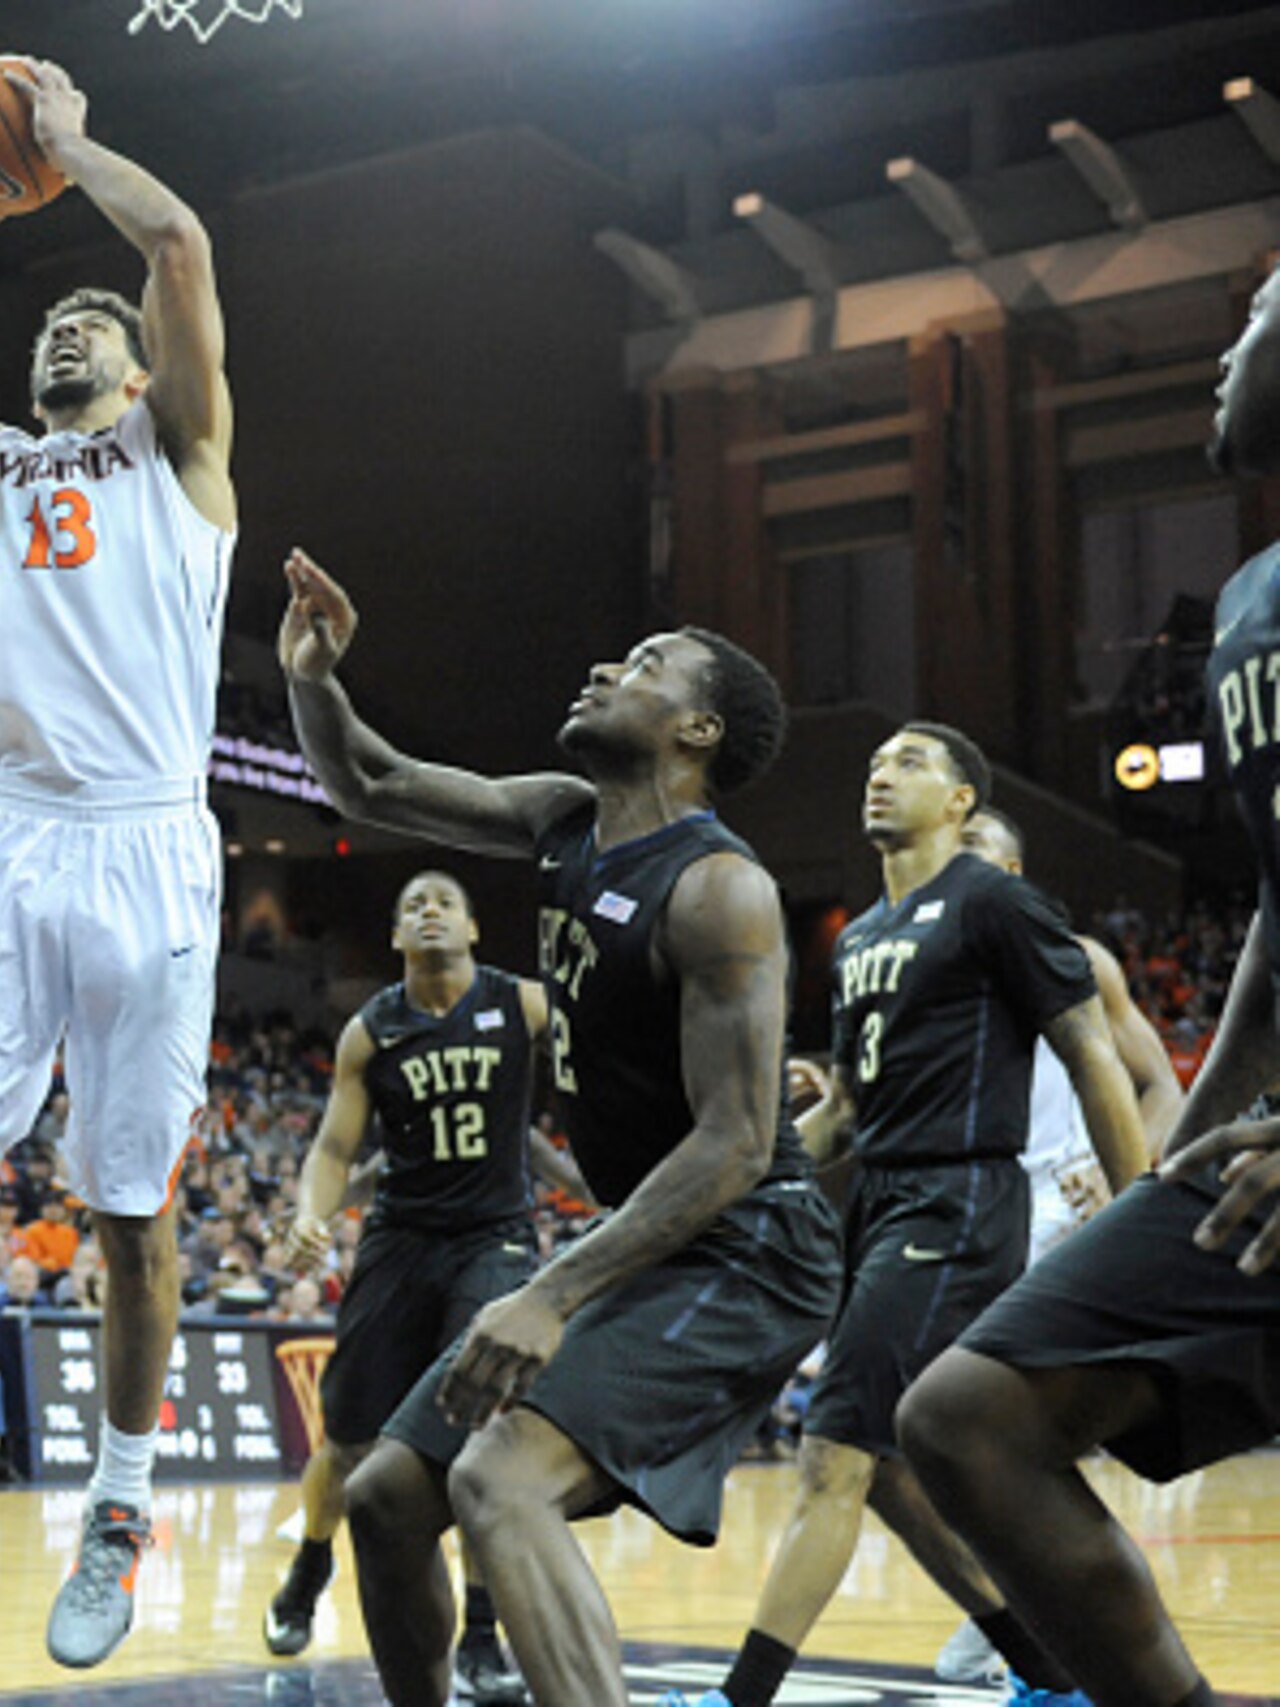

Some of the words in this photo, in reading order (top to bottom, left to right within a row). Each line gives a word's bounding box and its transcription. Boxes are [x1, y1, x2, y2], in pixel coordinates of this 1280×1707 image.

[21, 487, 97, 569] 13
[842, 938, 919, 1006] PITT
[400, 1046, 501, 1101] PITT
[859, 1011, 884, 1084] 3
[430, 1102, 487, 1162] 12
